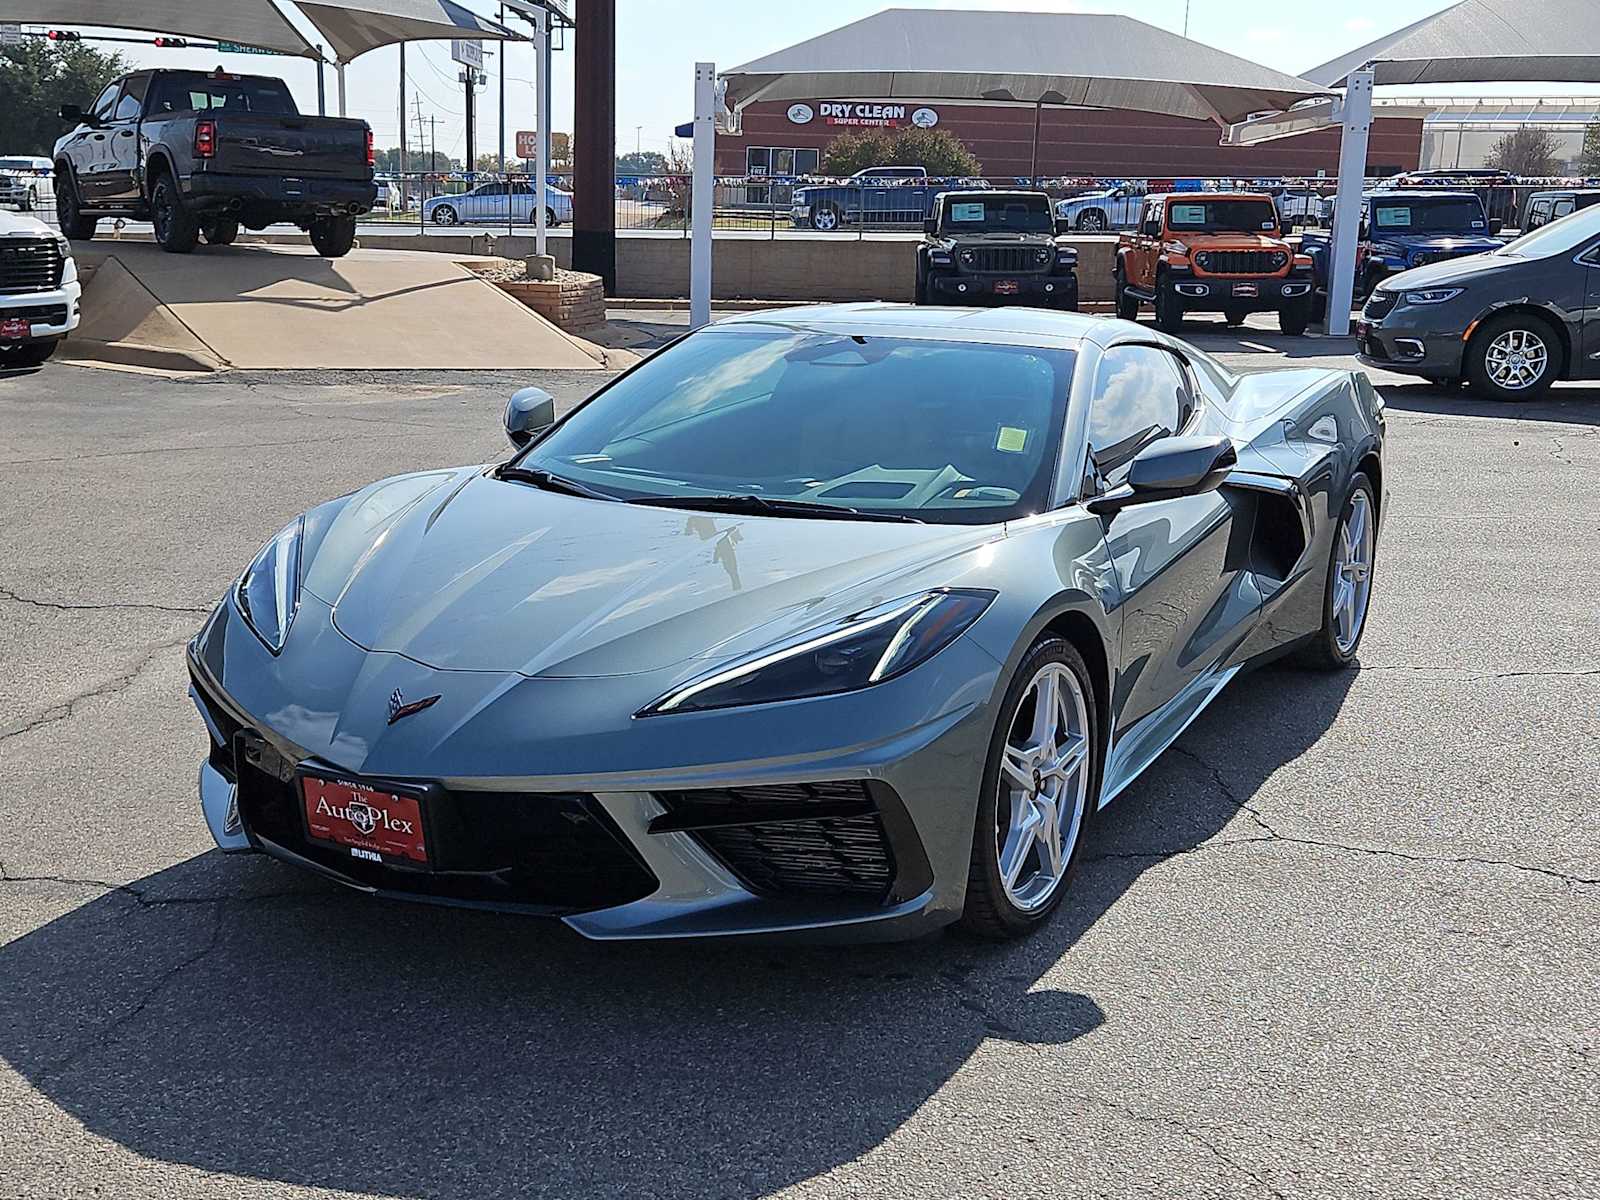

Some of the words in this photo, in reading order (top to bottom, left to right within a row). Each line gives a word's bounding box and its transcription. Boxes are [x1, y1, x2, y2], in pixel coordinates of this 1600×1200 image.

[820, 103, 852, 118] DRY
[855, 104, 905, 119] CLEAN
[833, 118, 859, 126] SUPER
[860, 119, 890, 128] CENTER
[352, 791, 368, 803] The
[315, 796, 413, 835] AutoPlex
[358, 849, 382, 862] LITHIA
